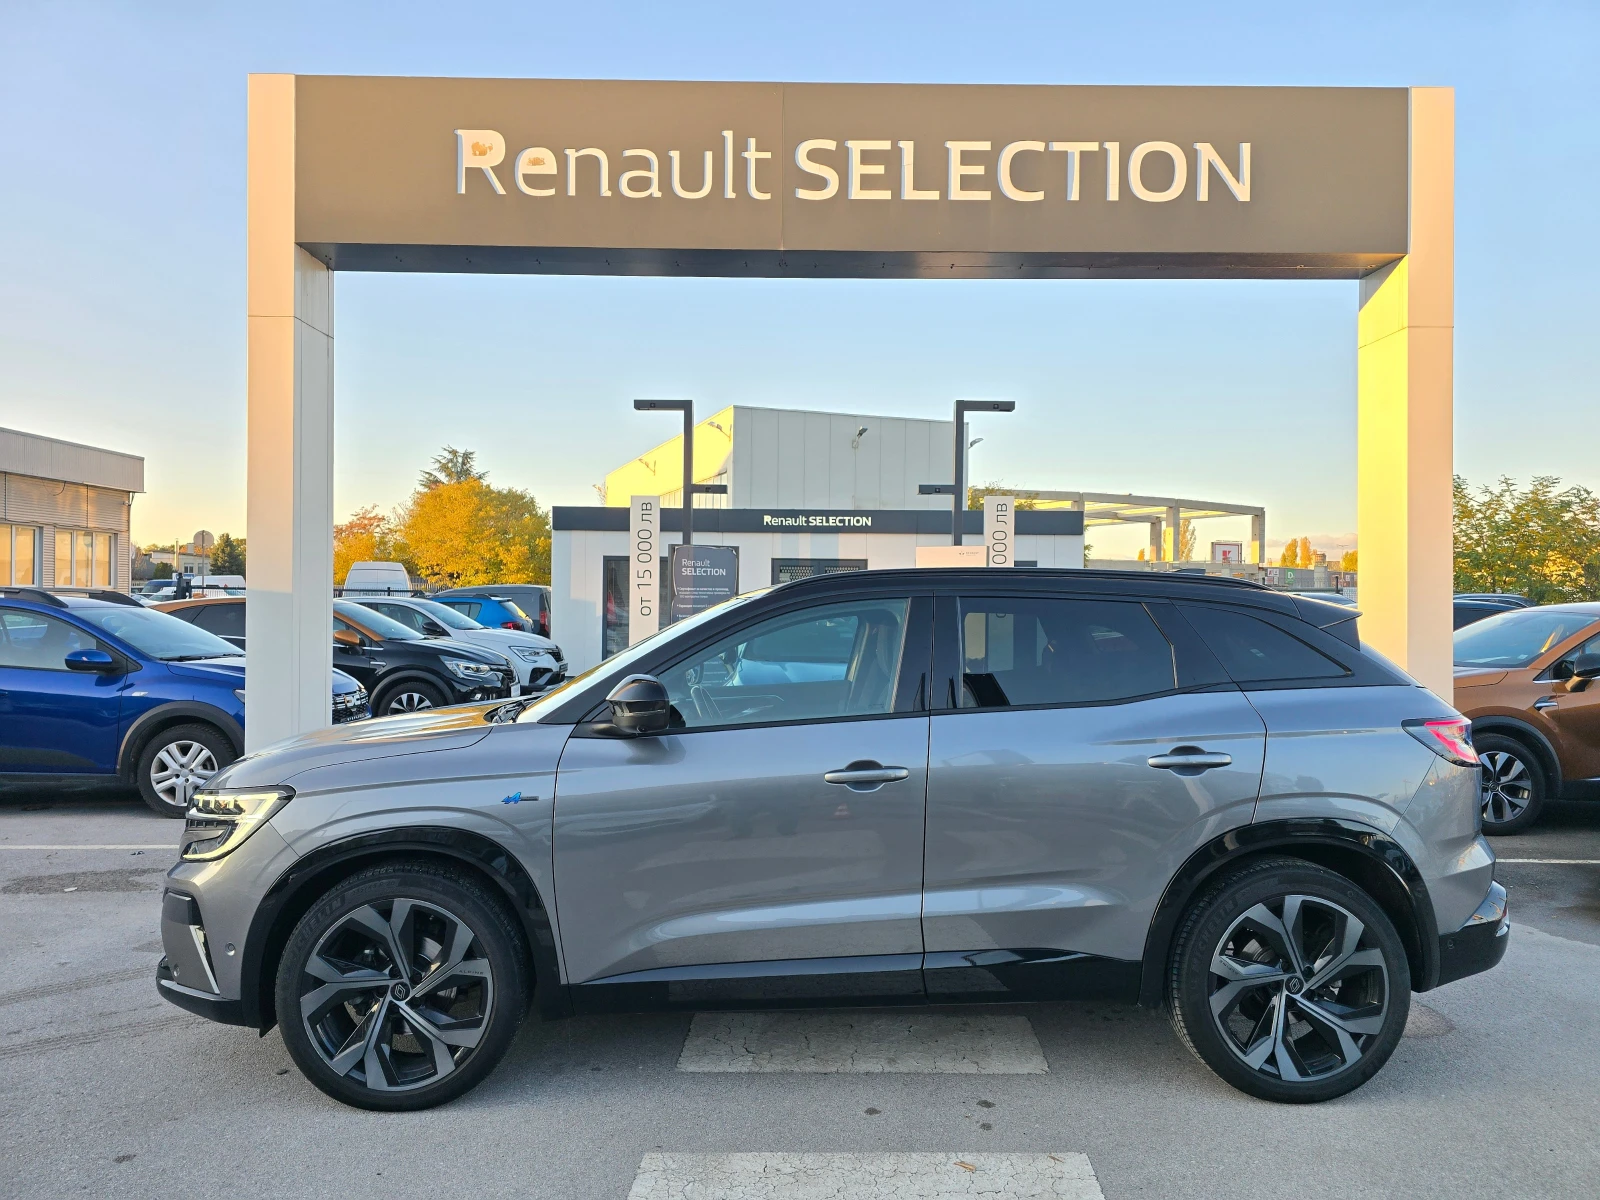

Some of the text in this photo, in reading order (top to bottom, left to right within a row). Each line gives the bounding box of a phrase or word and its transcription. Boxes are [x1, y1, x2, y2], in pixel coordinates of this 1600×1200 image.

[454, 127, 1253, 204] Renault SELECTION
[763, 514, 872, 527] Renault SELECTION
[637, 529, 653, 564] 000
[991, 530, 1007, 565] 000
[681, 558, 711, 567] Renault
[681, 567, 726, 576] SELECTION
[637, 569, 652, 590] 15
